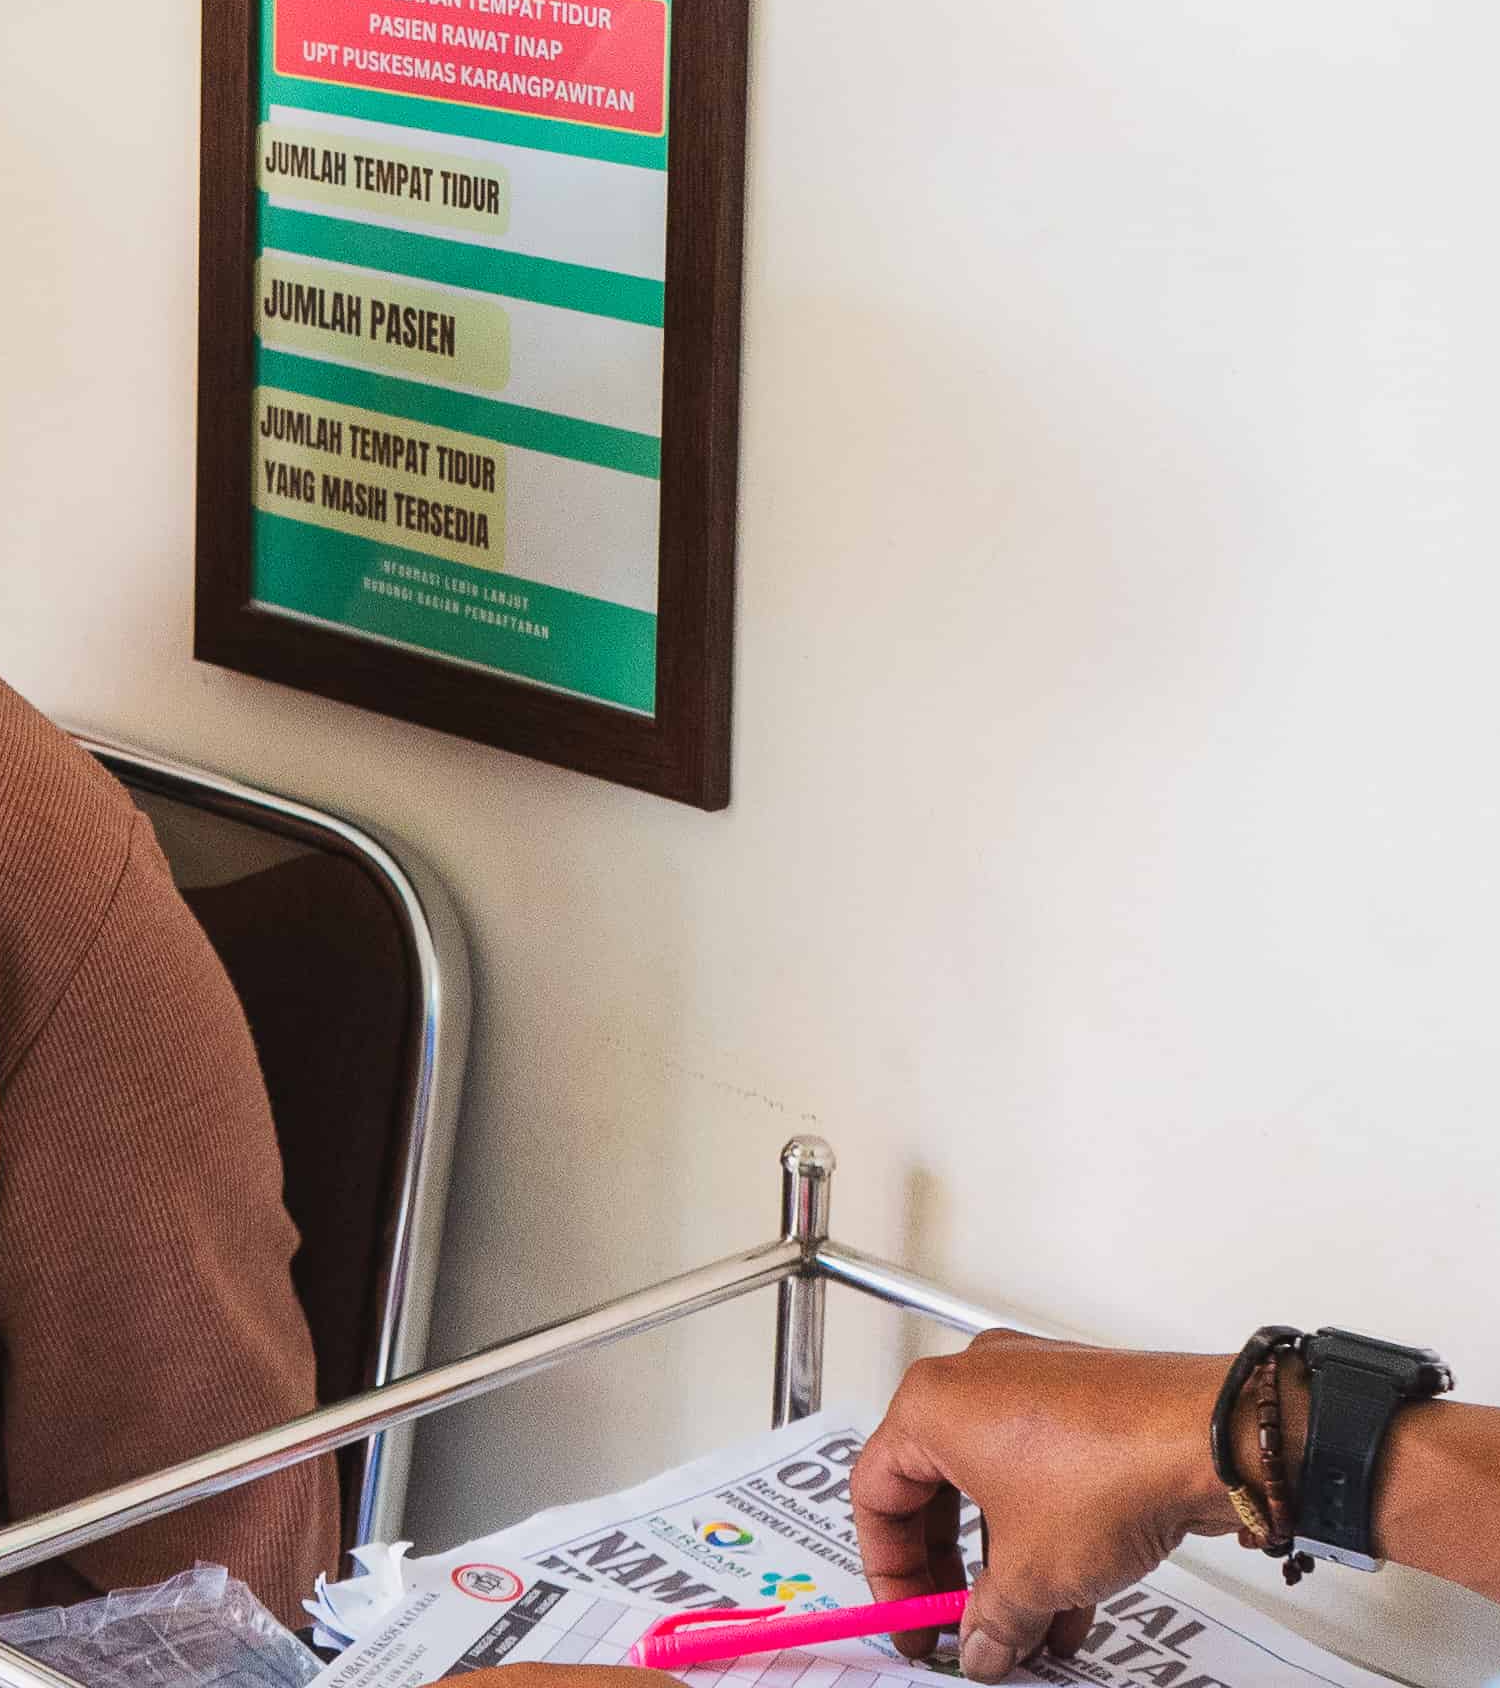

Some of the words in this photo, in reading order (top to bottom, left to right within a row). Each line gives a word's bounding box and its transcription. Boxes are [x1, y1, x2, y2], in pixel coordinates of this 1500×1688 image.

[369, 13, 437, 43] PASIEN
[442, 23, 508, 54] RAWAT
[515, 34, 563, 62] INAP
[550, 0, 612, 30] TIDUR
[303, 40, 339, 67] UPT
[343, 48, 457, 85] PUSKESMAS
[460, 65, 635, 113] KARANGPAWITAN
[265, 141, 347, 186] JUMLAH
[353, 155, 434, 203] TEMPAT
[440, 169, 500, 214] TIDUR
[264, 278, 361, 336] JUMLAH
[371, 299, 455, 357] PASIEN
[261, 405, 342, 455] JUMLAH
[348, 423, 430, 478] TEMPAT
[437, 442, 496, 493] TIDUR
[264, 459, 315, 505] YANG
[322, 475, 387, 522] MASIH
[393, 492, 490, 550] TERSEDIA
[484, 588, 529, 611] LANJUT
[746, 1478, 836, 1532] Berbasis
[649, 1516, 752, 1579] PERDAMI
[1103, 1591, 1206, 1659] IAL
